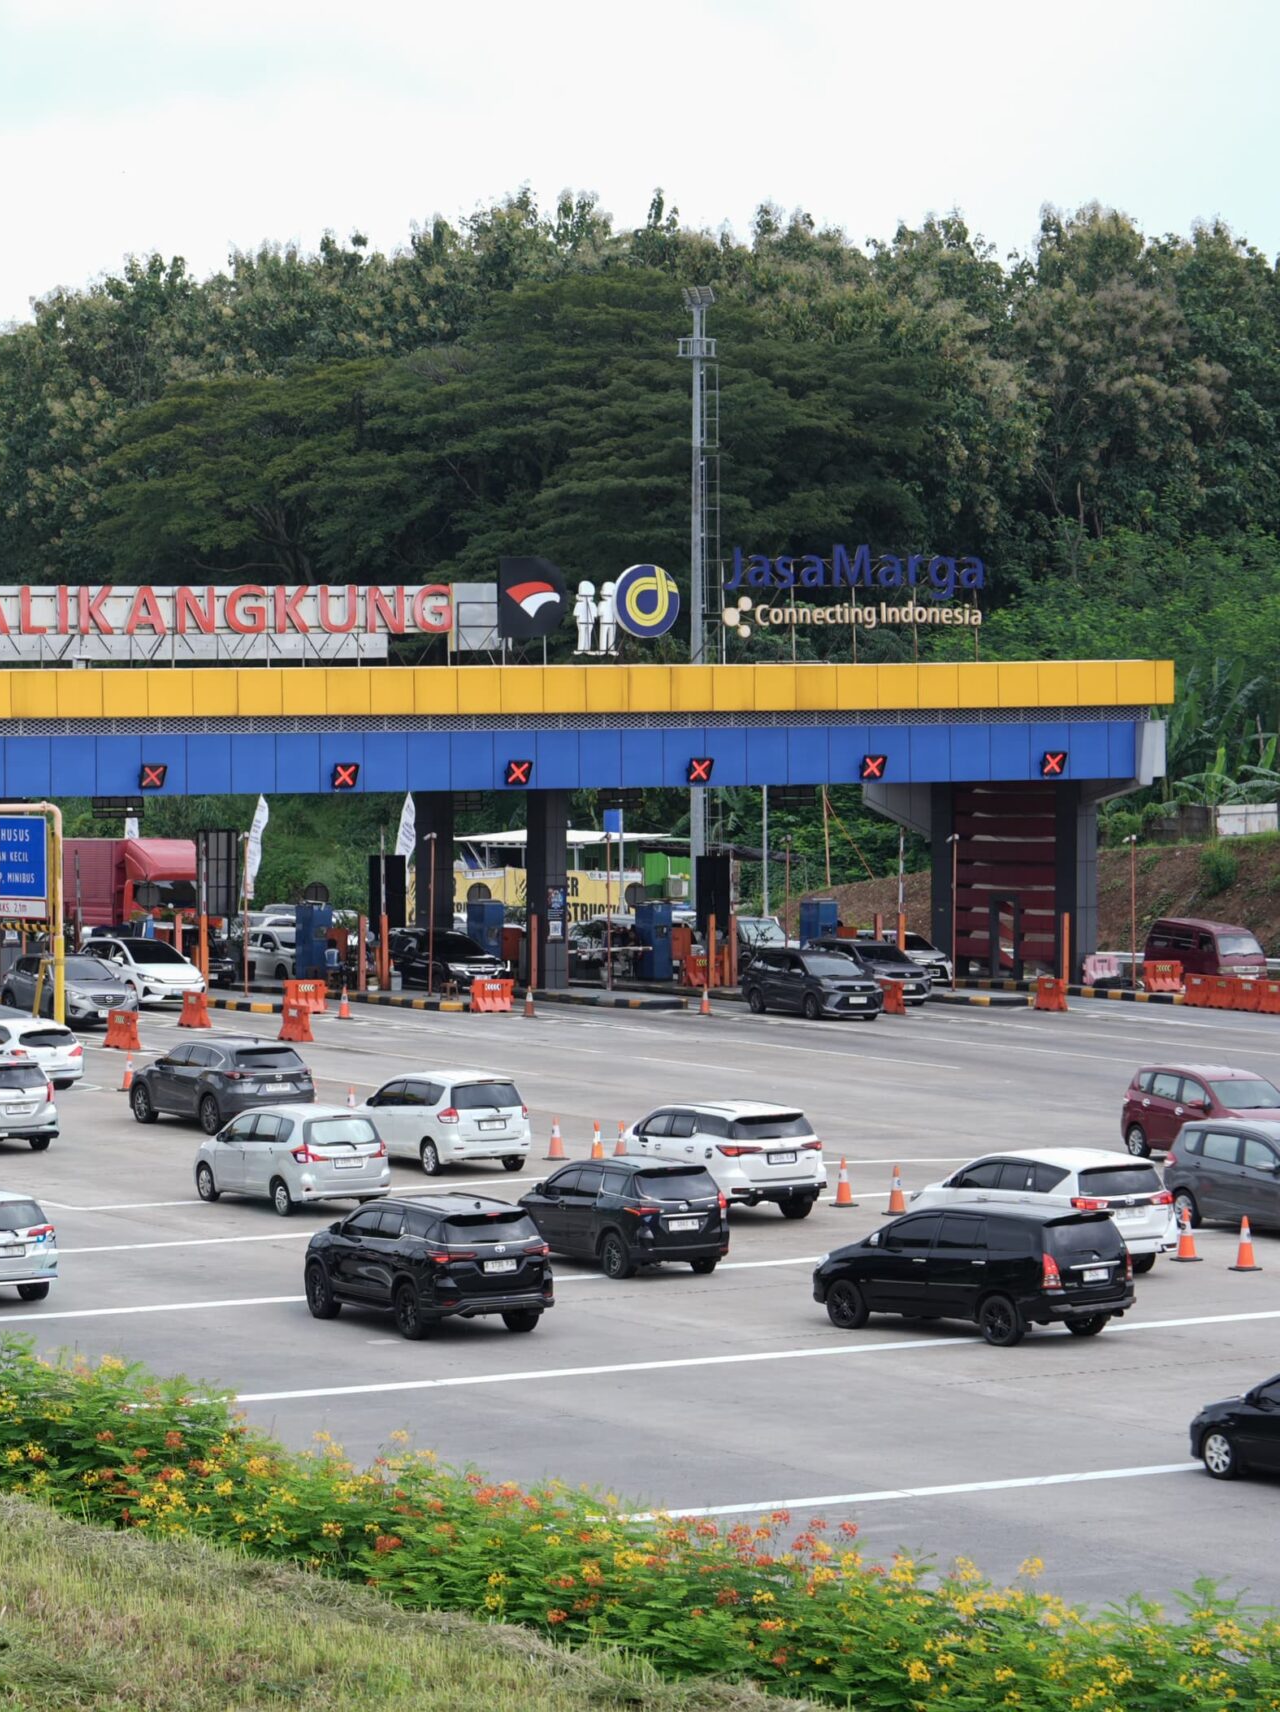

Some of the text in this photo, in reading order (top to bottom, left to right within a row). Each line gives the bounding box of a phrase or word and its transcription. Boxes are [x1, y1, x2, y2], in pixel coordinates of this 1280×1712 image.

[755, 600, 983, 629] Connecting Indonesia
[9, 851, 29, 862] KECIL
[7, 872, 35, 884] MINIBUS
